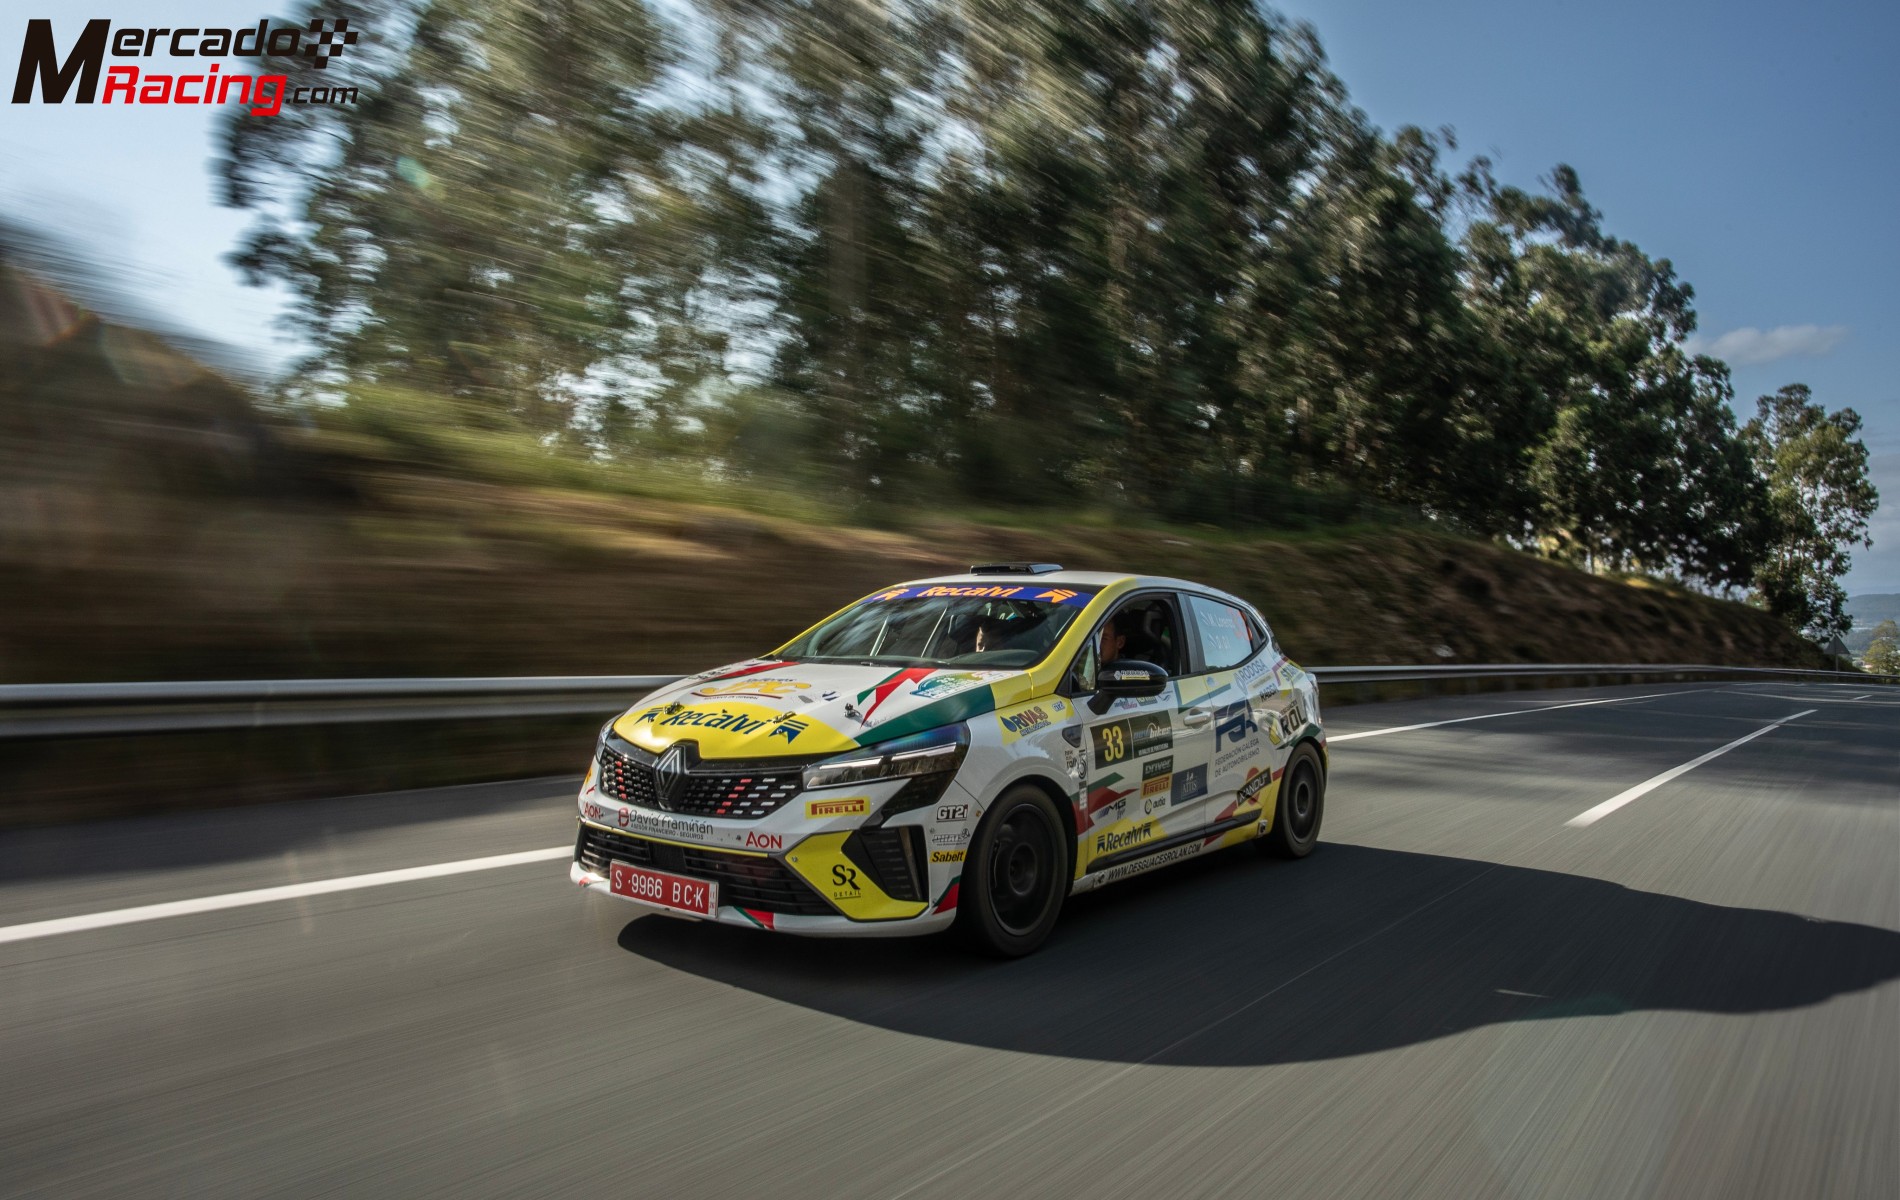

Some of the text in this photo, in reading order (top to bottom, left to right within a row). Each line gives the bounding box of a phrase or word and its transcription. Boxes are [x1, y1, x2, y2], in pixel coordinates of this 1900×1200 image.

[916, 586, 1025, 598] Recalvi
[659, 710, 770, 735] Recalvi
[1009, 705, 1049, 730] RIVAS
[1102, 725, 1124, 762] 33
[1143, 775, 1170, 796] PIRELLI
[585, 801, 601, 819] AON
[811, 799, 865, 816] PIRELLI
[937, 804, 968, 820] GT2i
[630, 809, 660, 827] David
[648, 826, 676, 836] FINANCIERO
[680, 831, 704, 840] SEGUROS
[745, 831, 782, 849] AON
[1106, 825, 1143, 852] Recalvi
[932, 851, 963, 862] Sabelt
[832, 864, 860, 890] SR
[615, 869, 704, 909] S 9966 BCK
[833, 889, 861, 898] DETAIL
